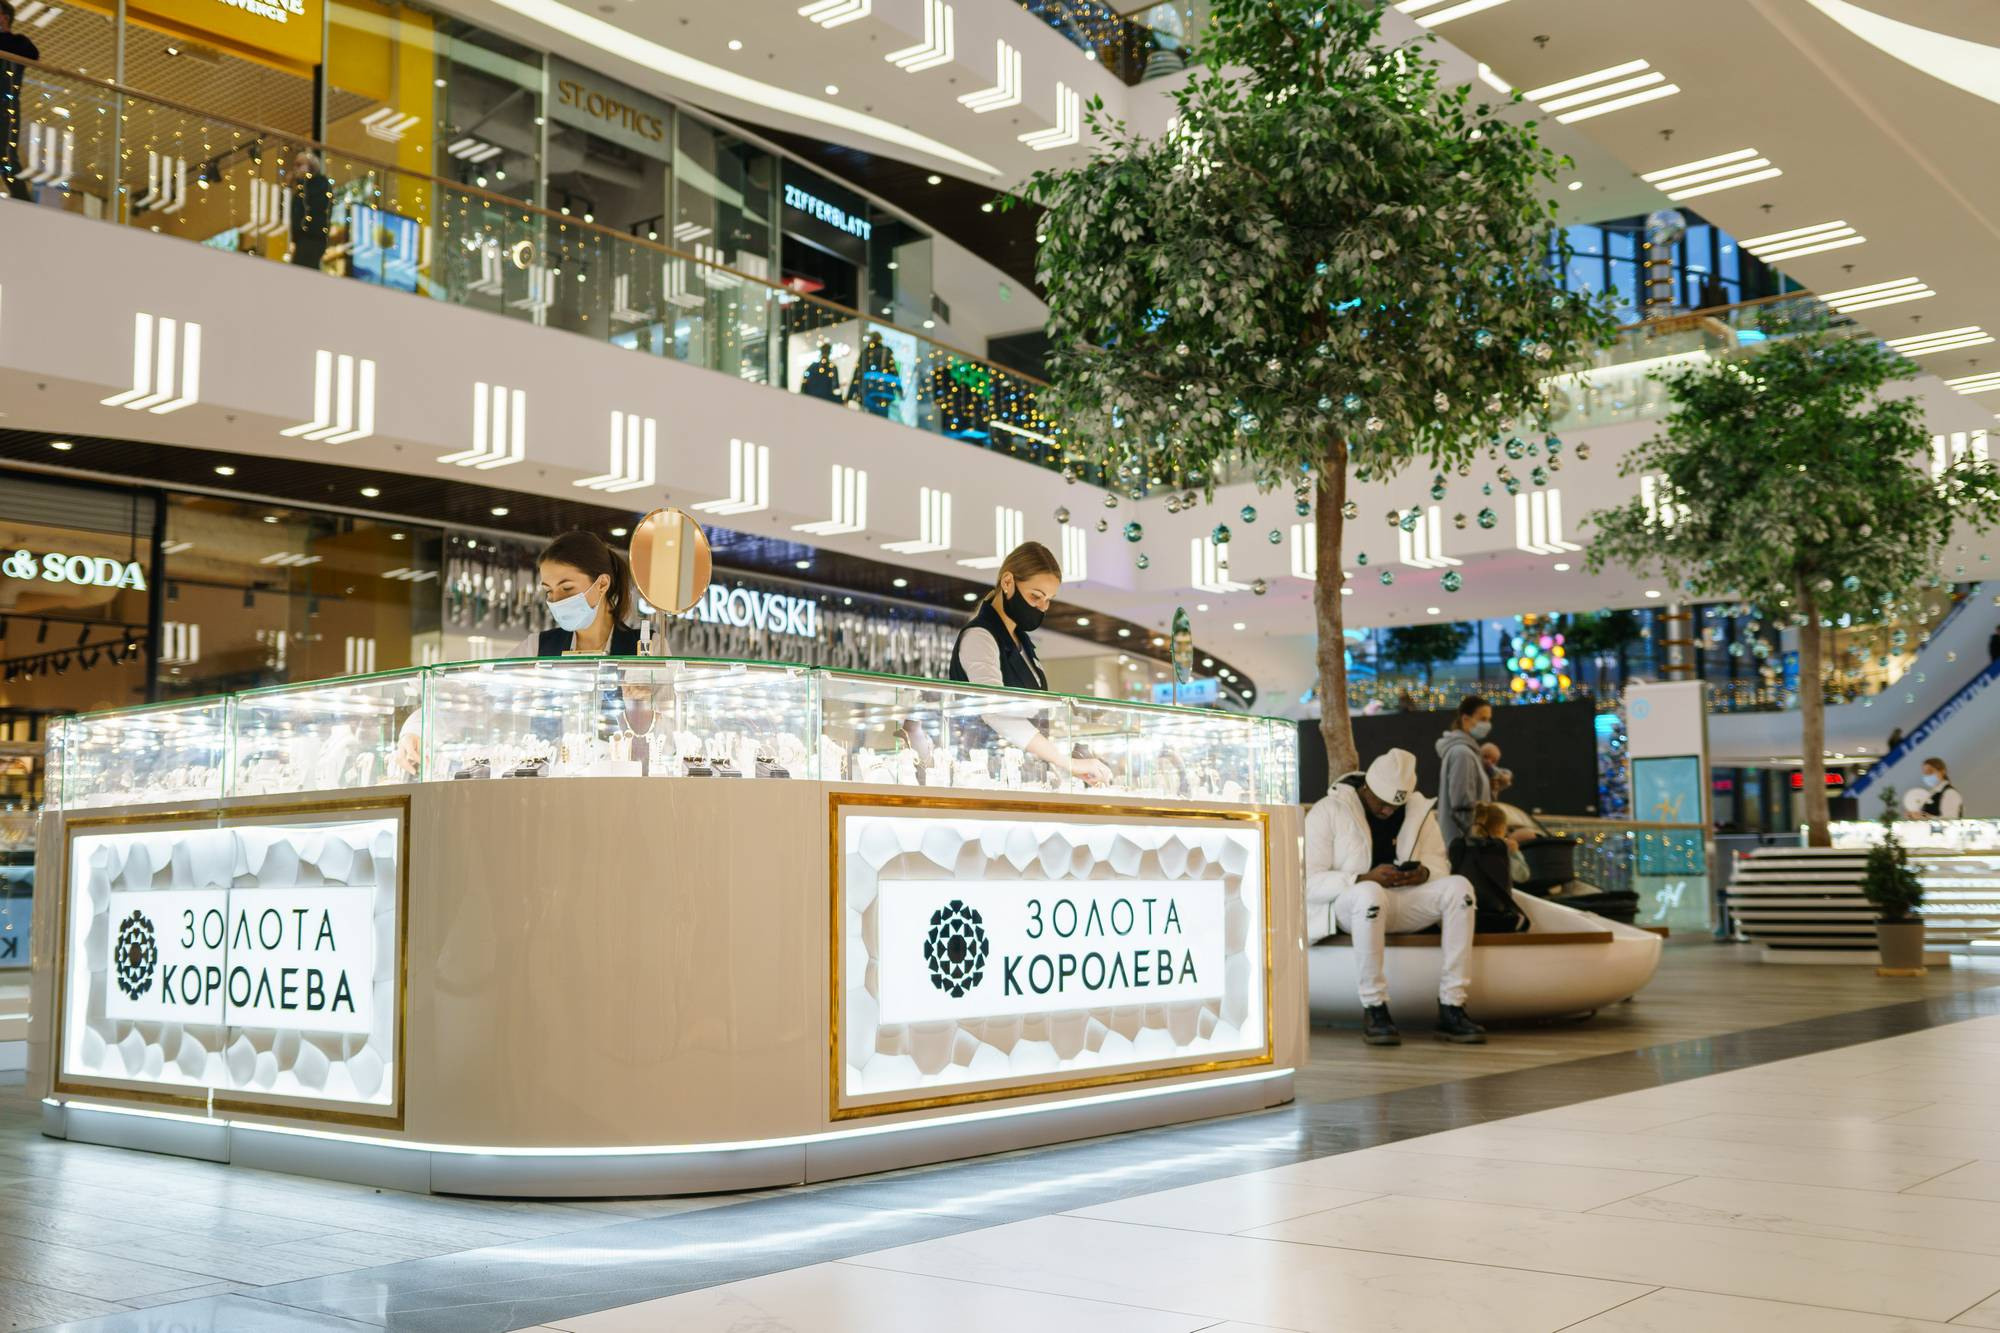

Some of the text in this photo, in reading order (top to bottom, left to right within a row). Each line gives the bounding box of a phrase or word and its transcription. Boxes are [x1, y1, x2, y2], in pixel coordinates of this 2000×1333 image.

[558, 79, 664, 142] ST.OPTICS
[784, 184, 871, 240] ZIFFERBLATT
[2, 549, 147, 591] & SODA
[638, 584, 816, 637] AROVSKI
[181, 908, 336, 951] ЗОЛОТА
[1026, 898, 1182, 939] ЗОЛОТА
[162, 964, 355, 1013] КОРОЛЕВА
[1004, 948, 1198, 996] КОРОЛЕВА
